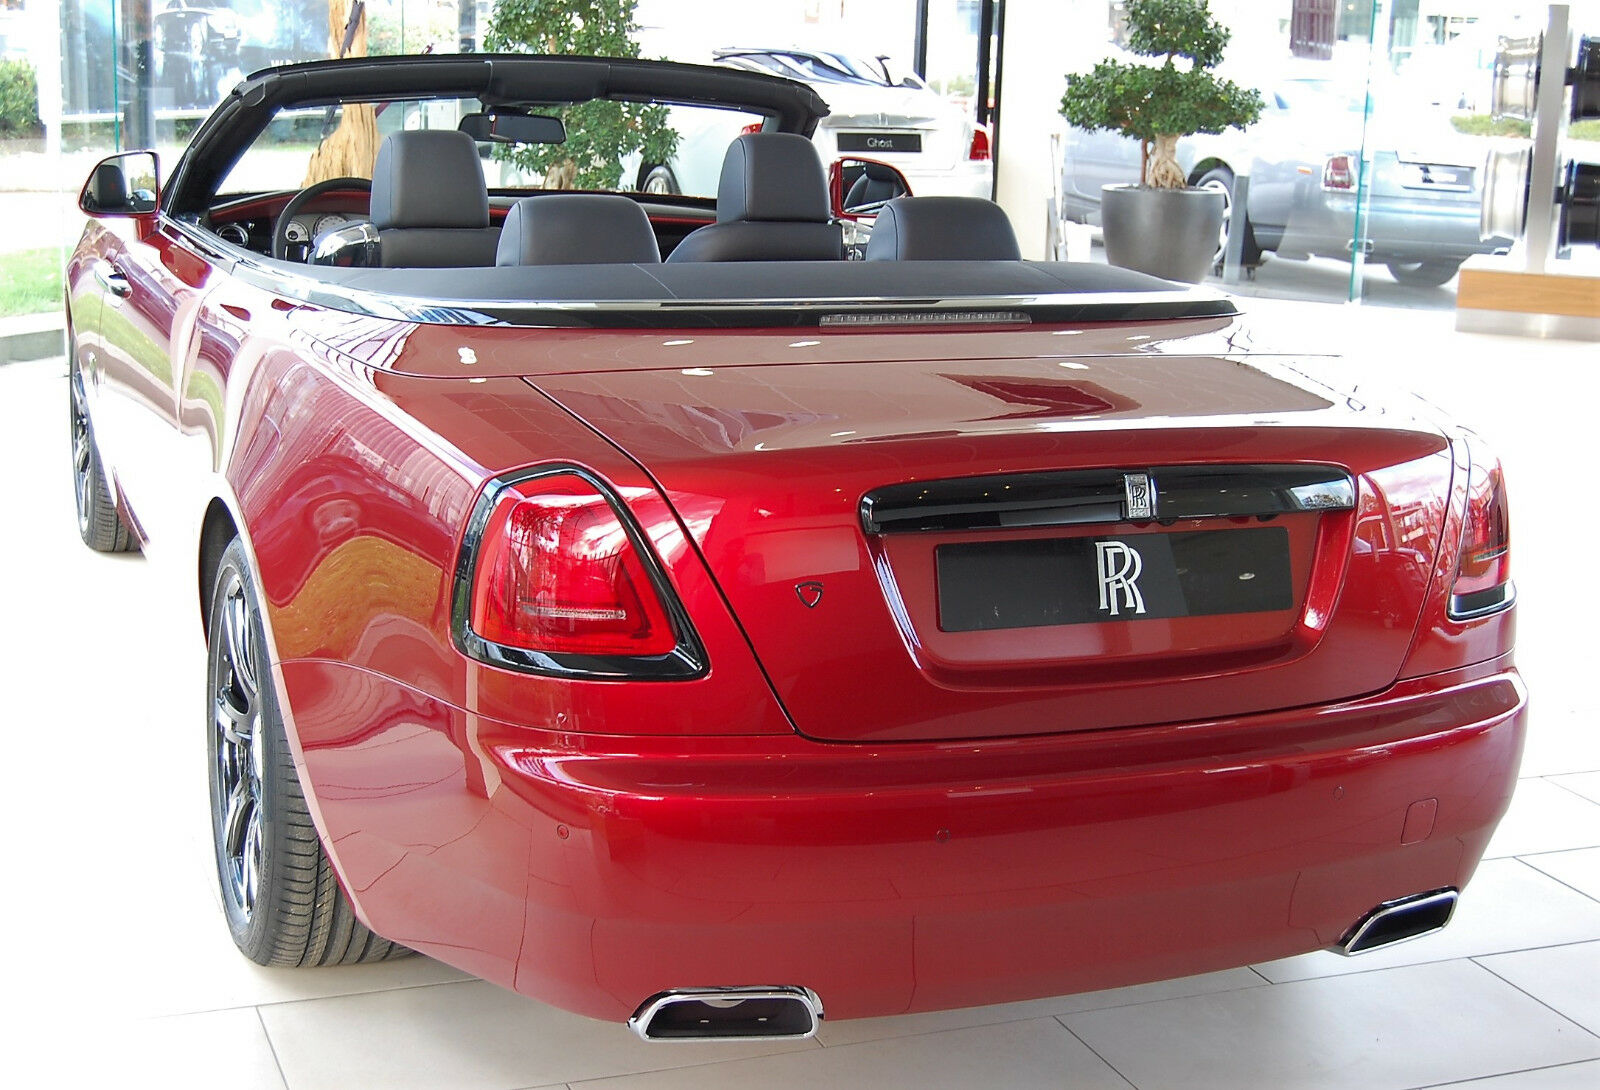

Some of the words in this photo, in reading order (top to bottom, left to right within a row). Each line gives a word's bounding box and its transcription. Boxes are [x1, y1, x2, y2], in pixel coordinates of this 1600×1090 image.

[867, 137, 893, 148] Ghost
[1131, 484, 1147, 508] RR
[1095, 541, 1146, 615] RR
